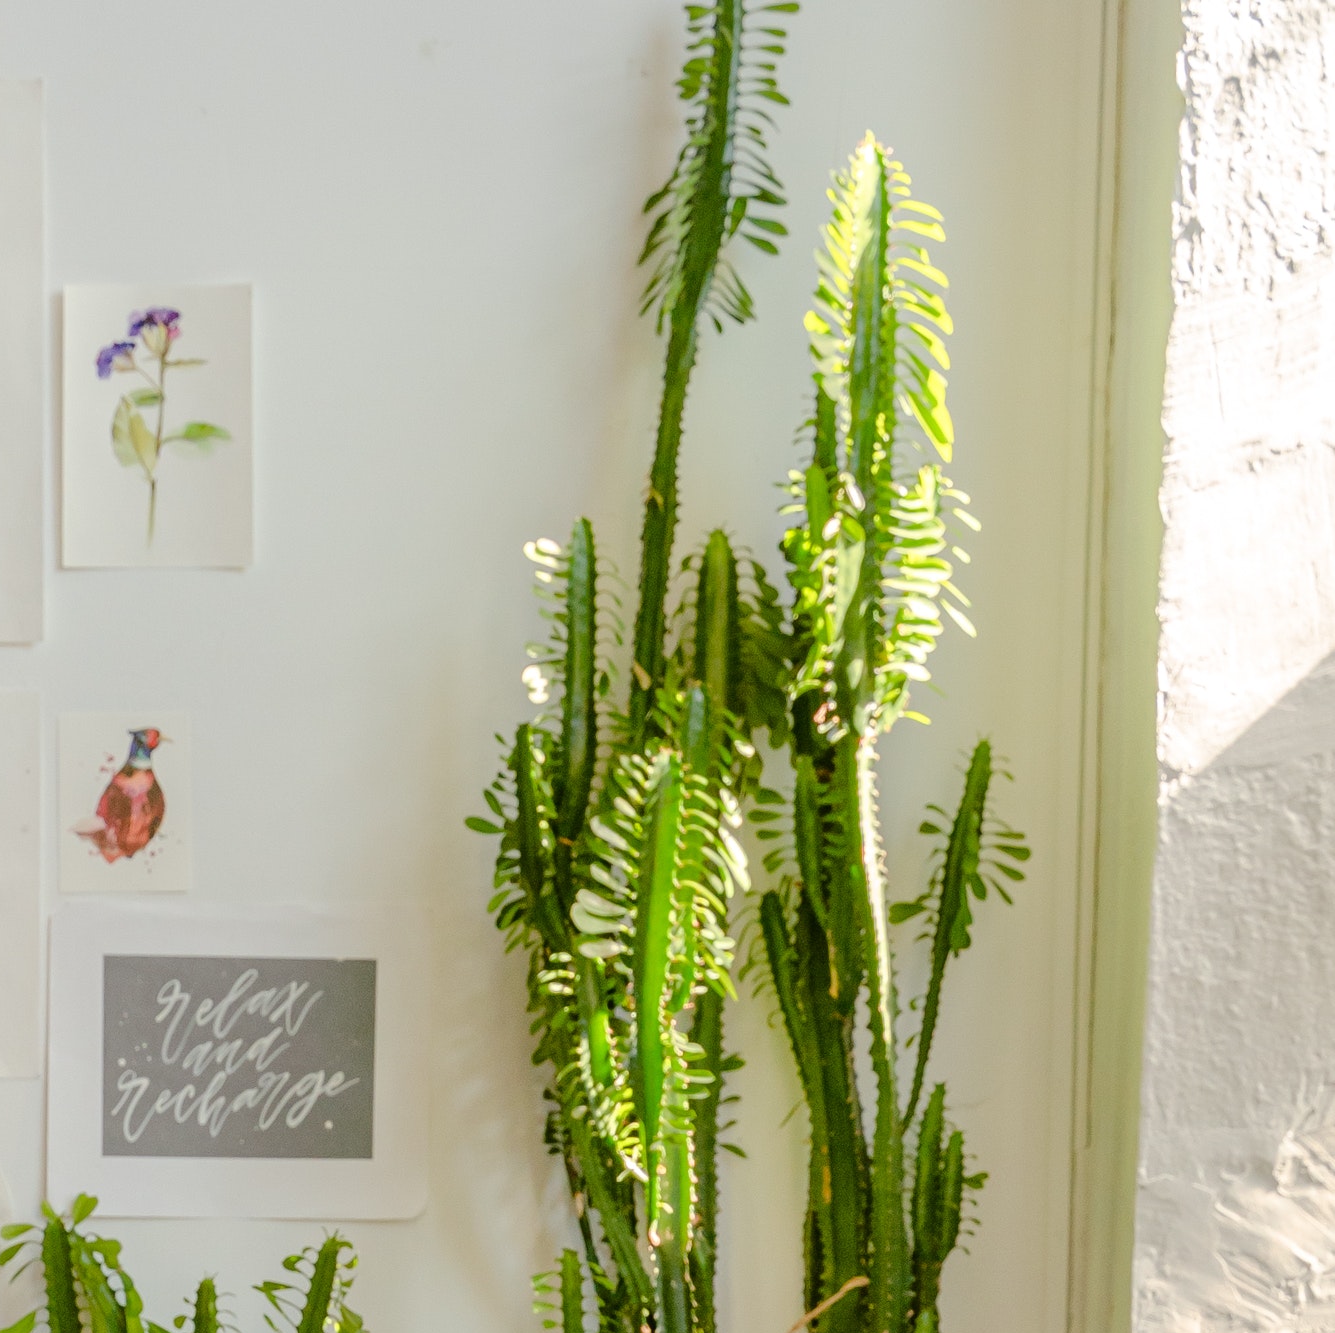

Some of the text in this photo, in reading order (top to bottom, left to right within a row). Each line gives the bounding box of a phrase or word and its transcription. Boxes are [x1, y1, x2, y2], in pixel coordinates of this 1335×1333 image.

[154, 967, 323, 1064] relax
[182, 1026, 290, 1076] and
[111, 1069, 360, 1144] recharge
